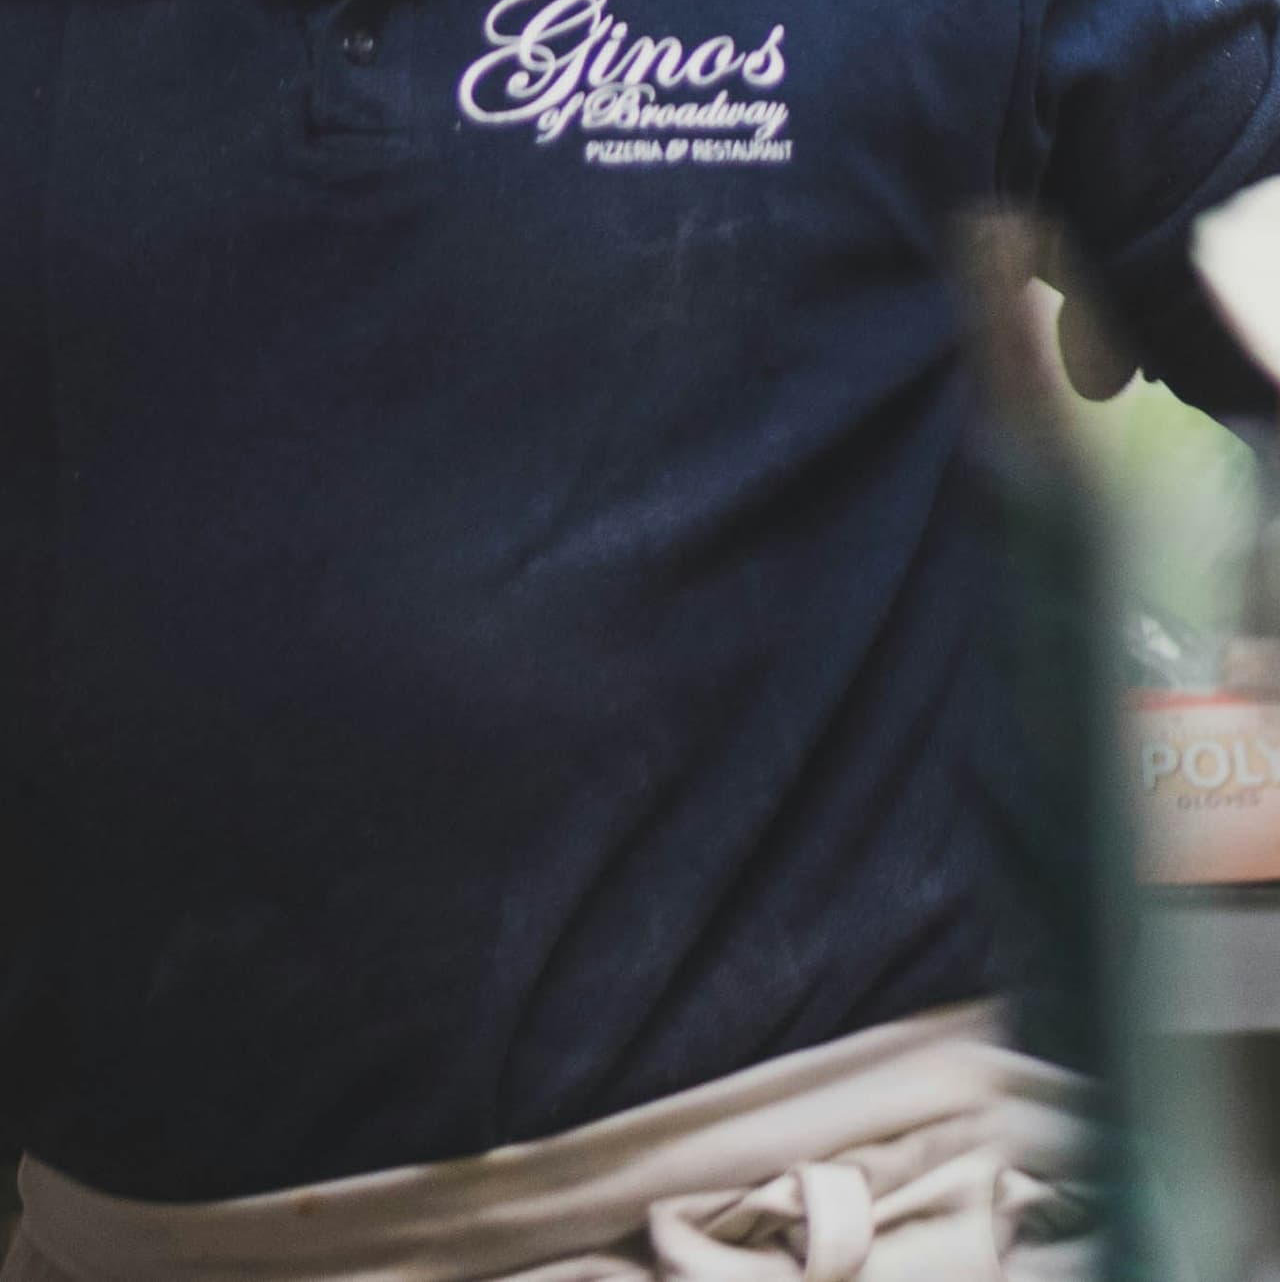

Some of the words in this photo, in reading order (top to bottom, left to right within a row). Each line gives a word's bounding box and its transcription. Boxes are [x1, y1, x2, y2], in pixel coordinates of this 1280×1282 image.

[536, 91, 586, 145] of
[581, 81, 790, 142] Broadway
[585, 138, 663, 162] PIZZERIA
[692, 139, 792, 162] RESTAURANT
